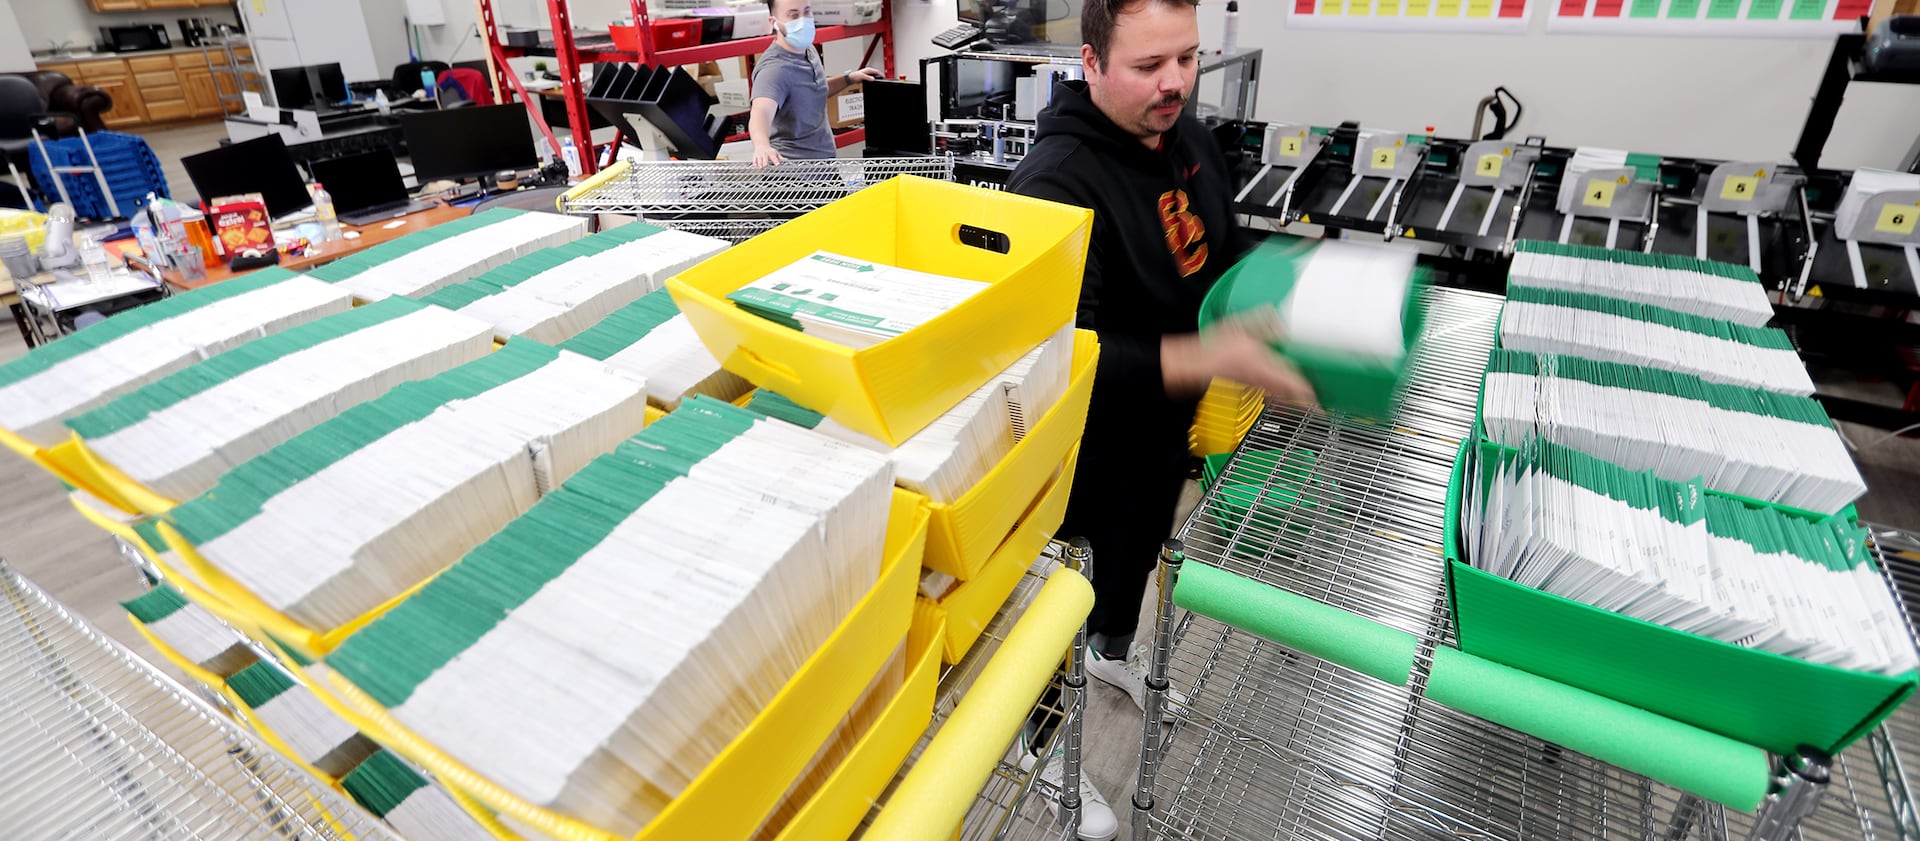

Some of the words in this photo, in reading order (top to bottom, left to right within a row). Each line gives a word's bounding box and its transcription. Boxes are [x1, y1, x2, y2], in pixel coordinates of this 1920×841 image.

[1380, 155, 1388, 163] 2
[1484, 161, 1492, 170] 3
[1735, 183, 1746, 193] 5
[1592, 190, 1602, 200] 4
[1892, 214, 1904, 224] 6
